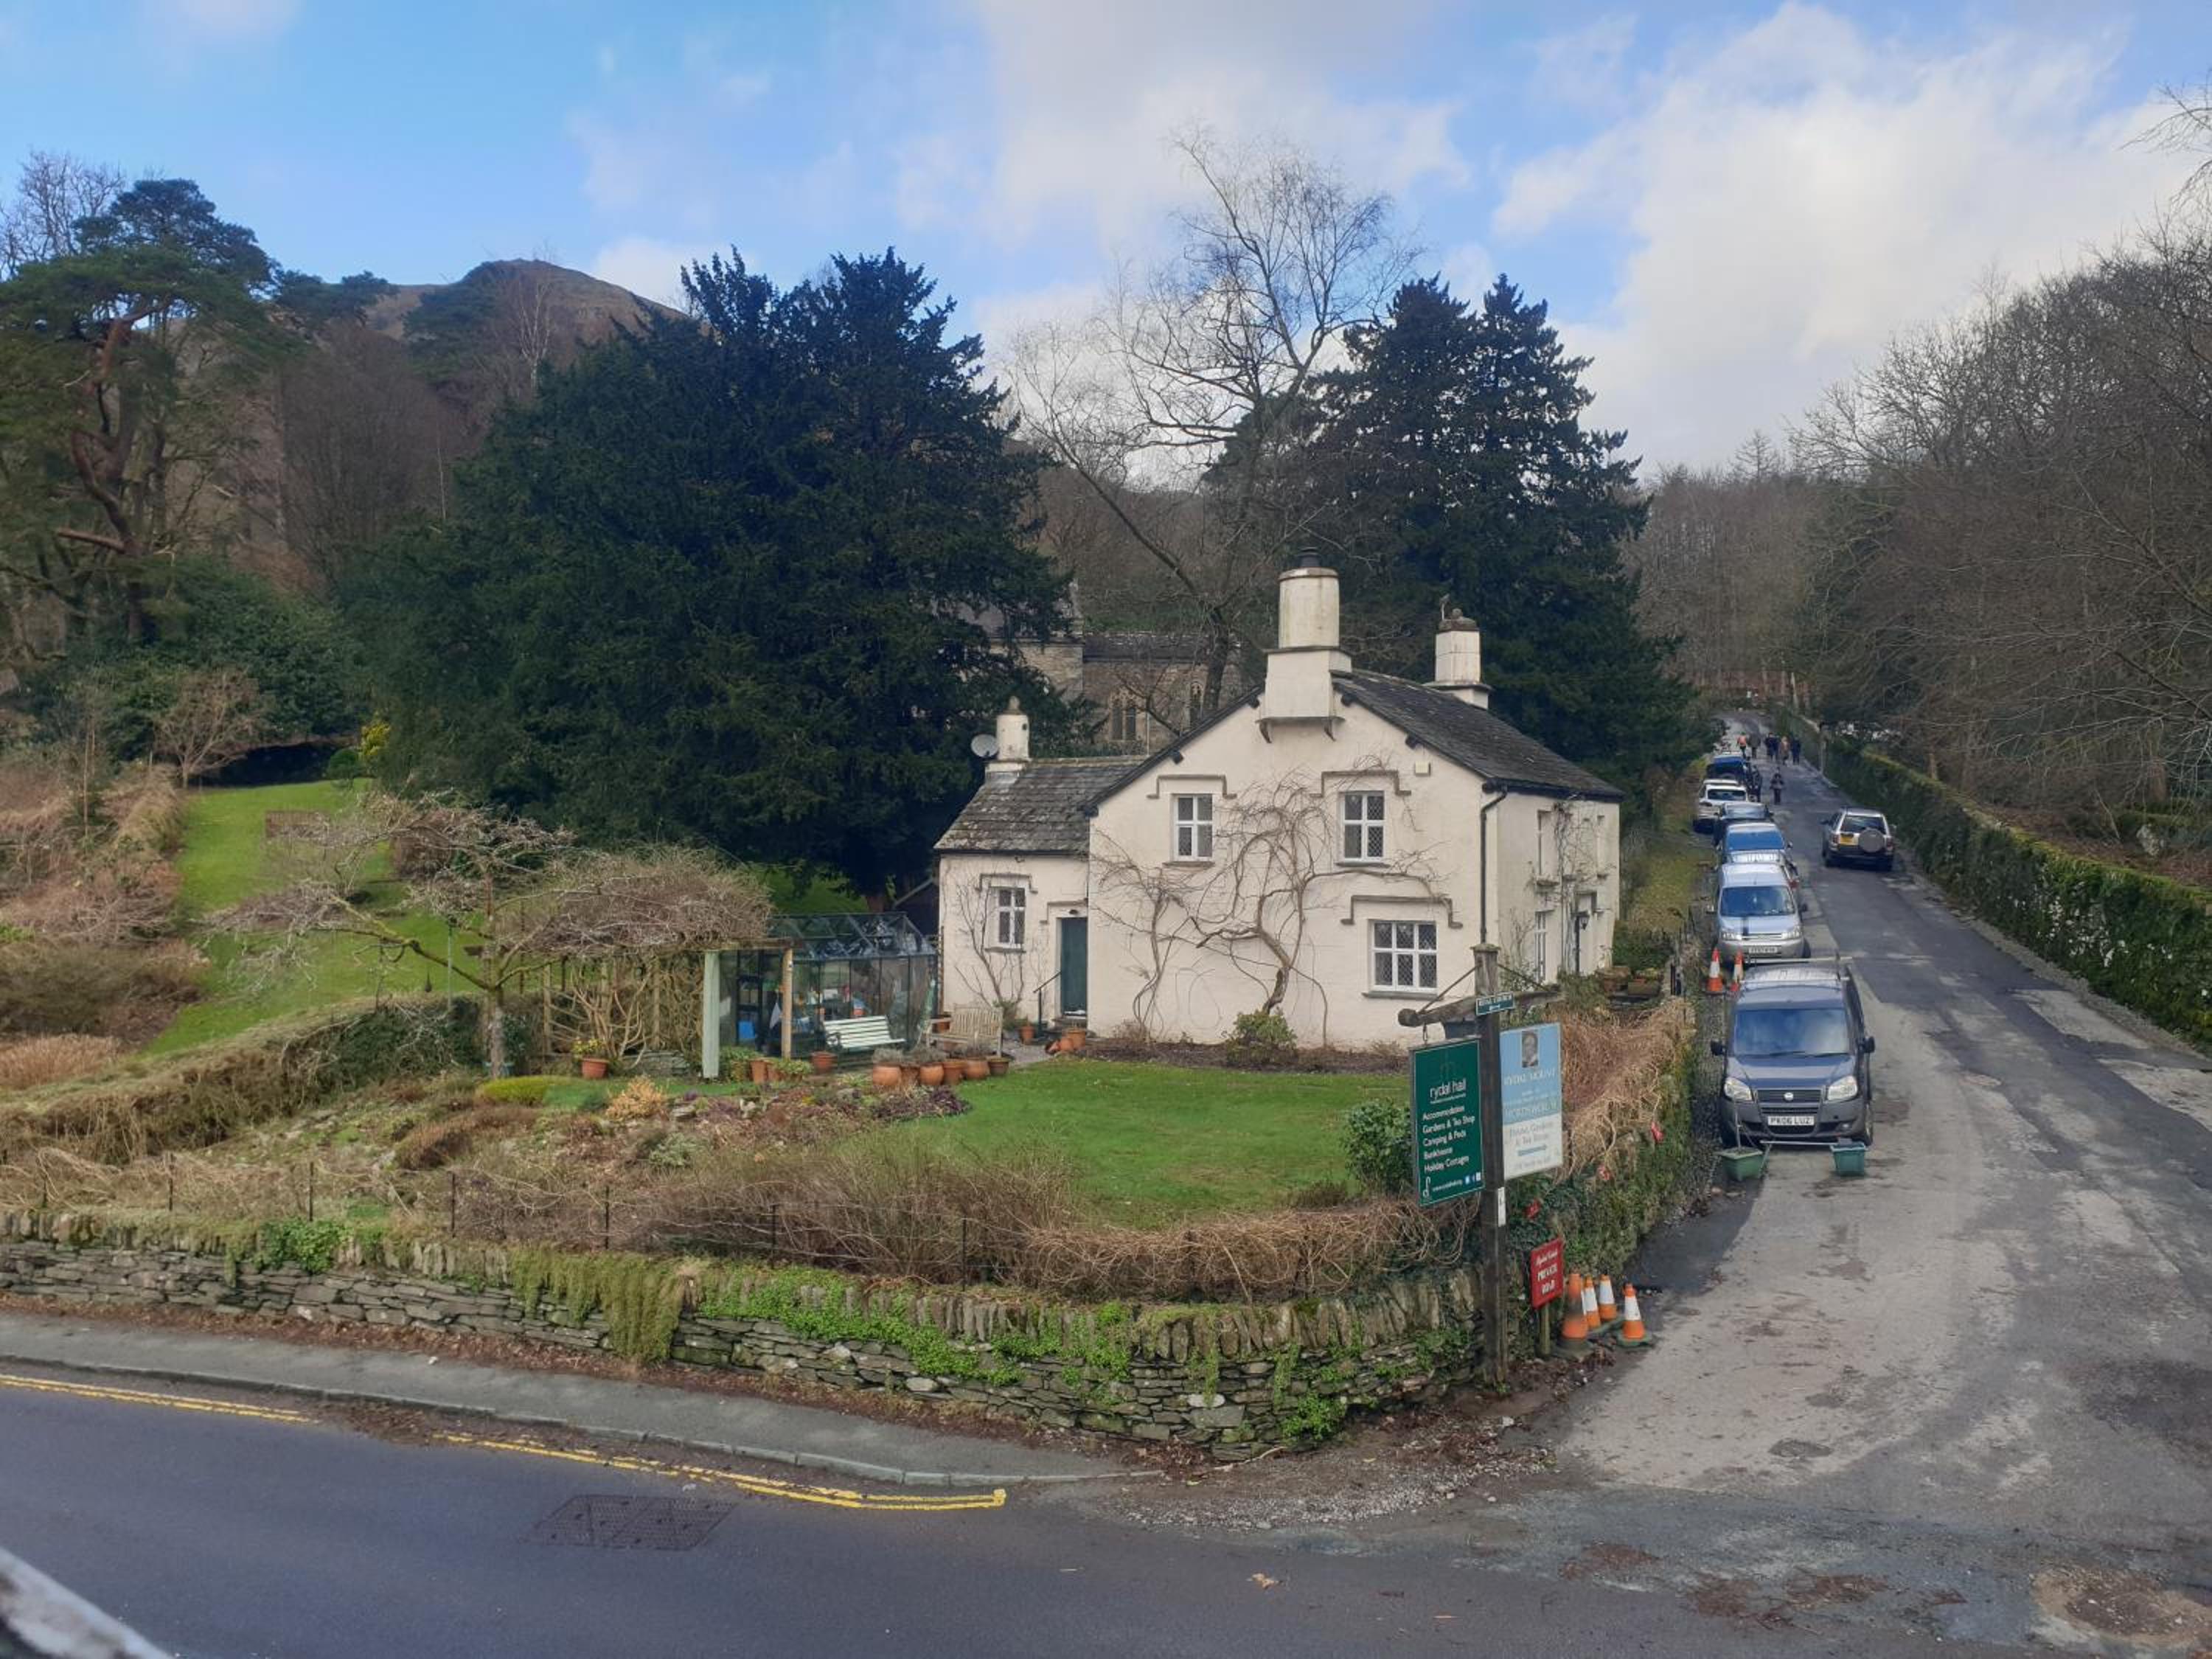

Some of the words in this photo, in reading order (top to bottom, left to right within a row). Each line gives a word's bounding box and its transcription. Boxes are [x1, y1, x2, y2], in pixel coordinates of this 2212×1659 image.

[1430, 1082, 1450, 1100] rydal
[1453, 1079, 1466, 1093] hall
[1462, 1115, 1475, 1125] Shop
[1423, 1135, 1447, 1147] Camping
